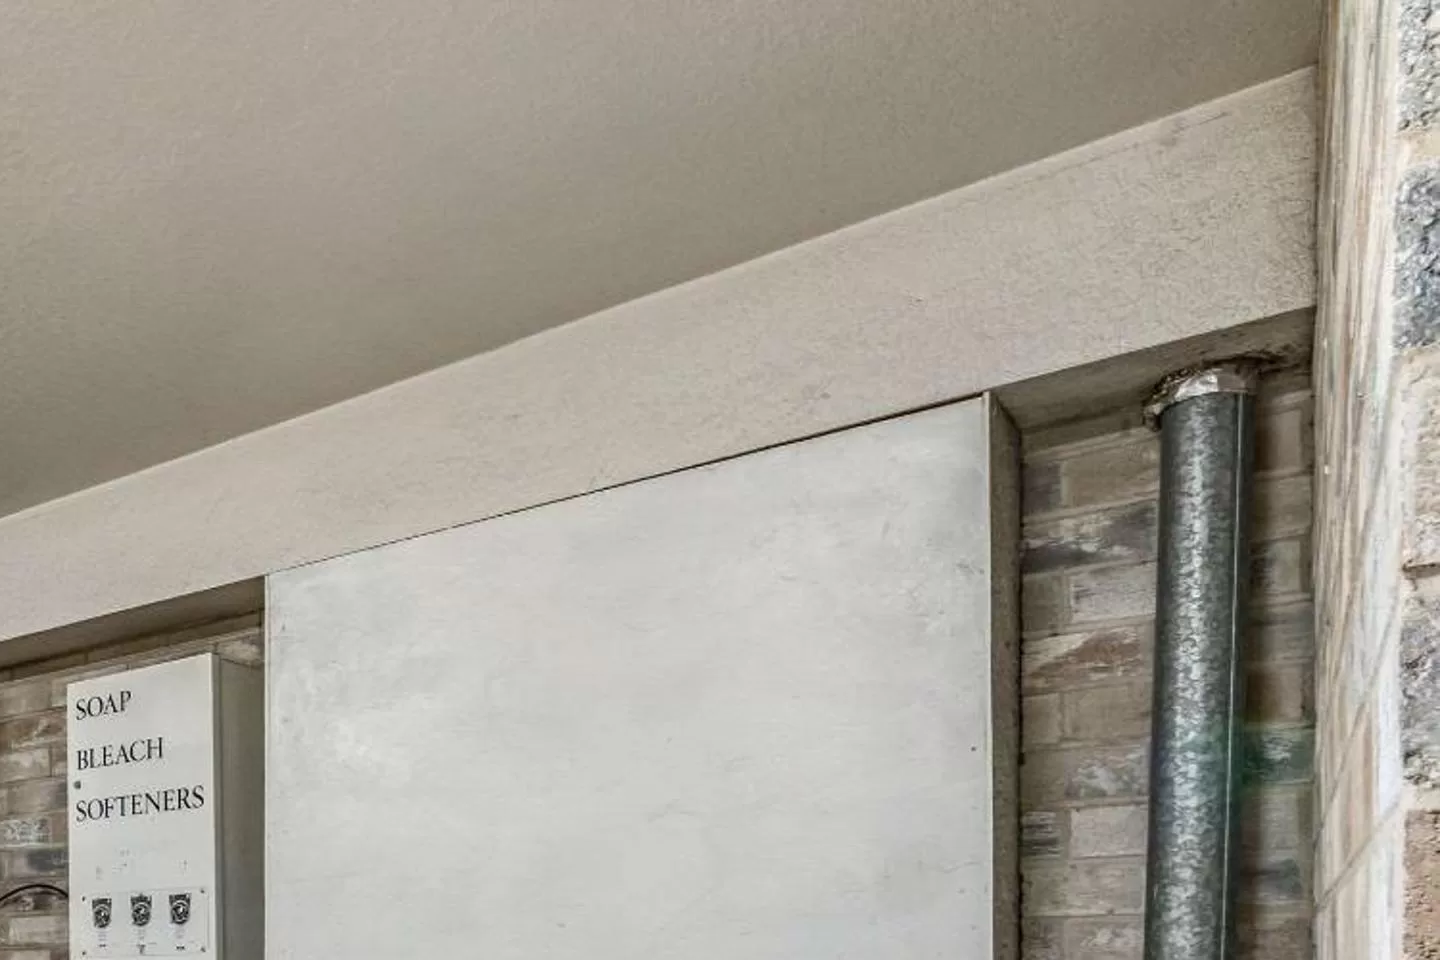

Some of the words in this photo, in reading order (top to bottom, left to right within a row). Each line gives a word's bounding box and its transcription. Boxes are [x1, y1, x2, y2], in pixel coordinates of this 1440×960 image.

[76, 690, 132, 721] SOAP
[76, 737, 164, 770] BLEACH
[76, 785, 205, 823] SOFTENERS
